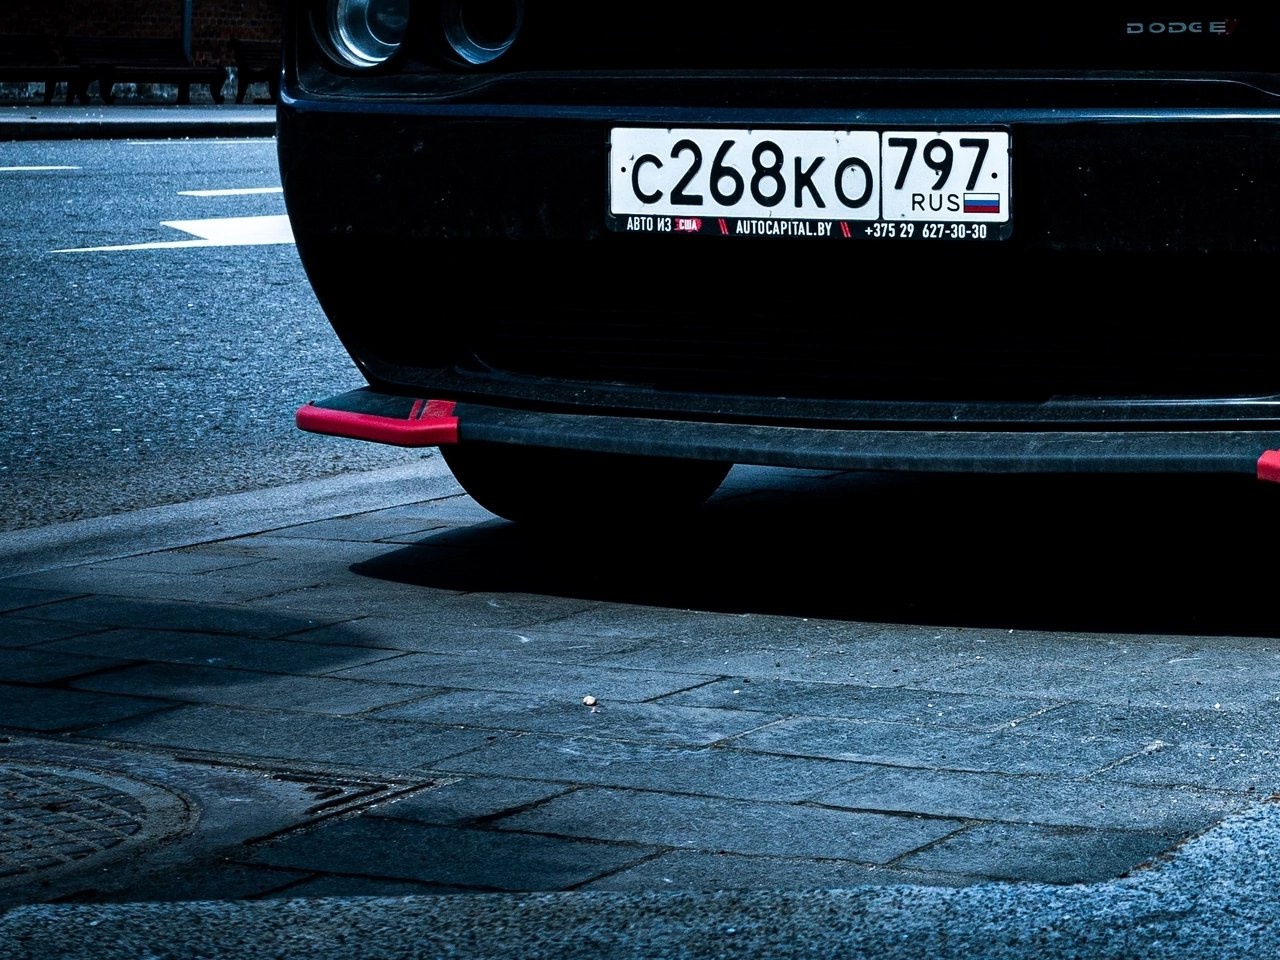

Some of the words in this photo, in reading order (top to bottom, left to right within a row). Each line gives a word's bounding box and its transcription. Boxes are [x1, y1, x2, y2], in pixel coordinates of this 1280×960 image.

[1126, 21, 1226, 34] DODGE
[888, 137, 990, 191] 797
[911, 192, 961, 212] RUS
[626, 216, 653, 231] АВТО
[657, 217, 672, 232] ИЗ
[678, 218, 698, 231] США
[735, 219, 833, 237] AUTOCAPITAL.BY
[864, 222, 896, 238] +375
[899, 223, 915, 238] 29
[922, 224, 987, 239] 627-30-30
